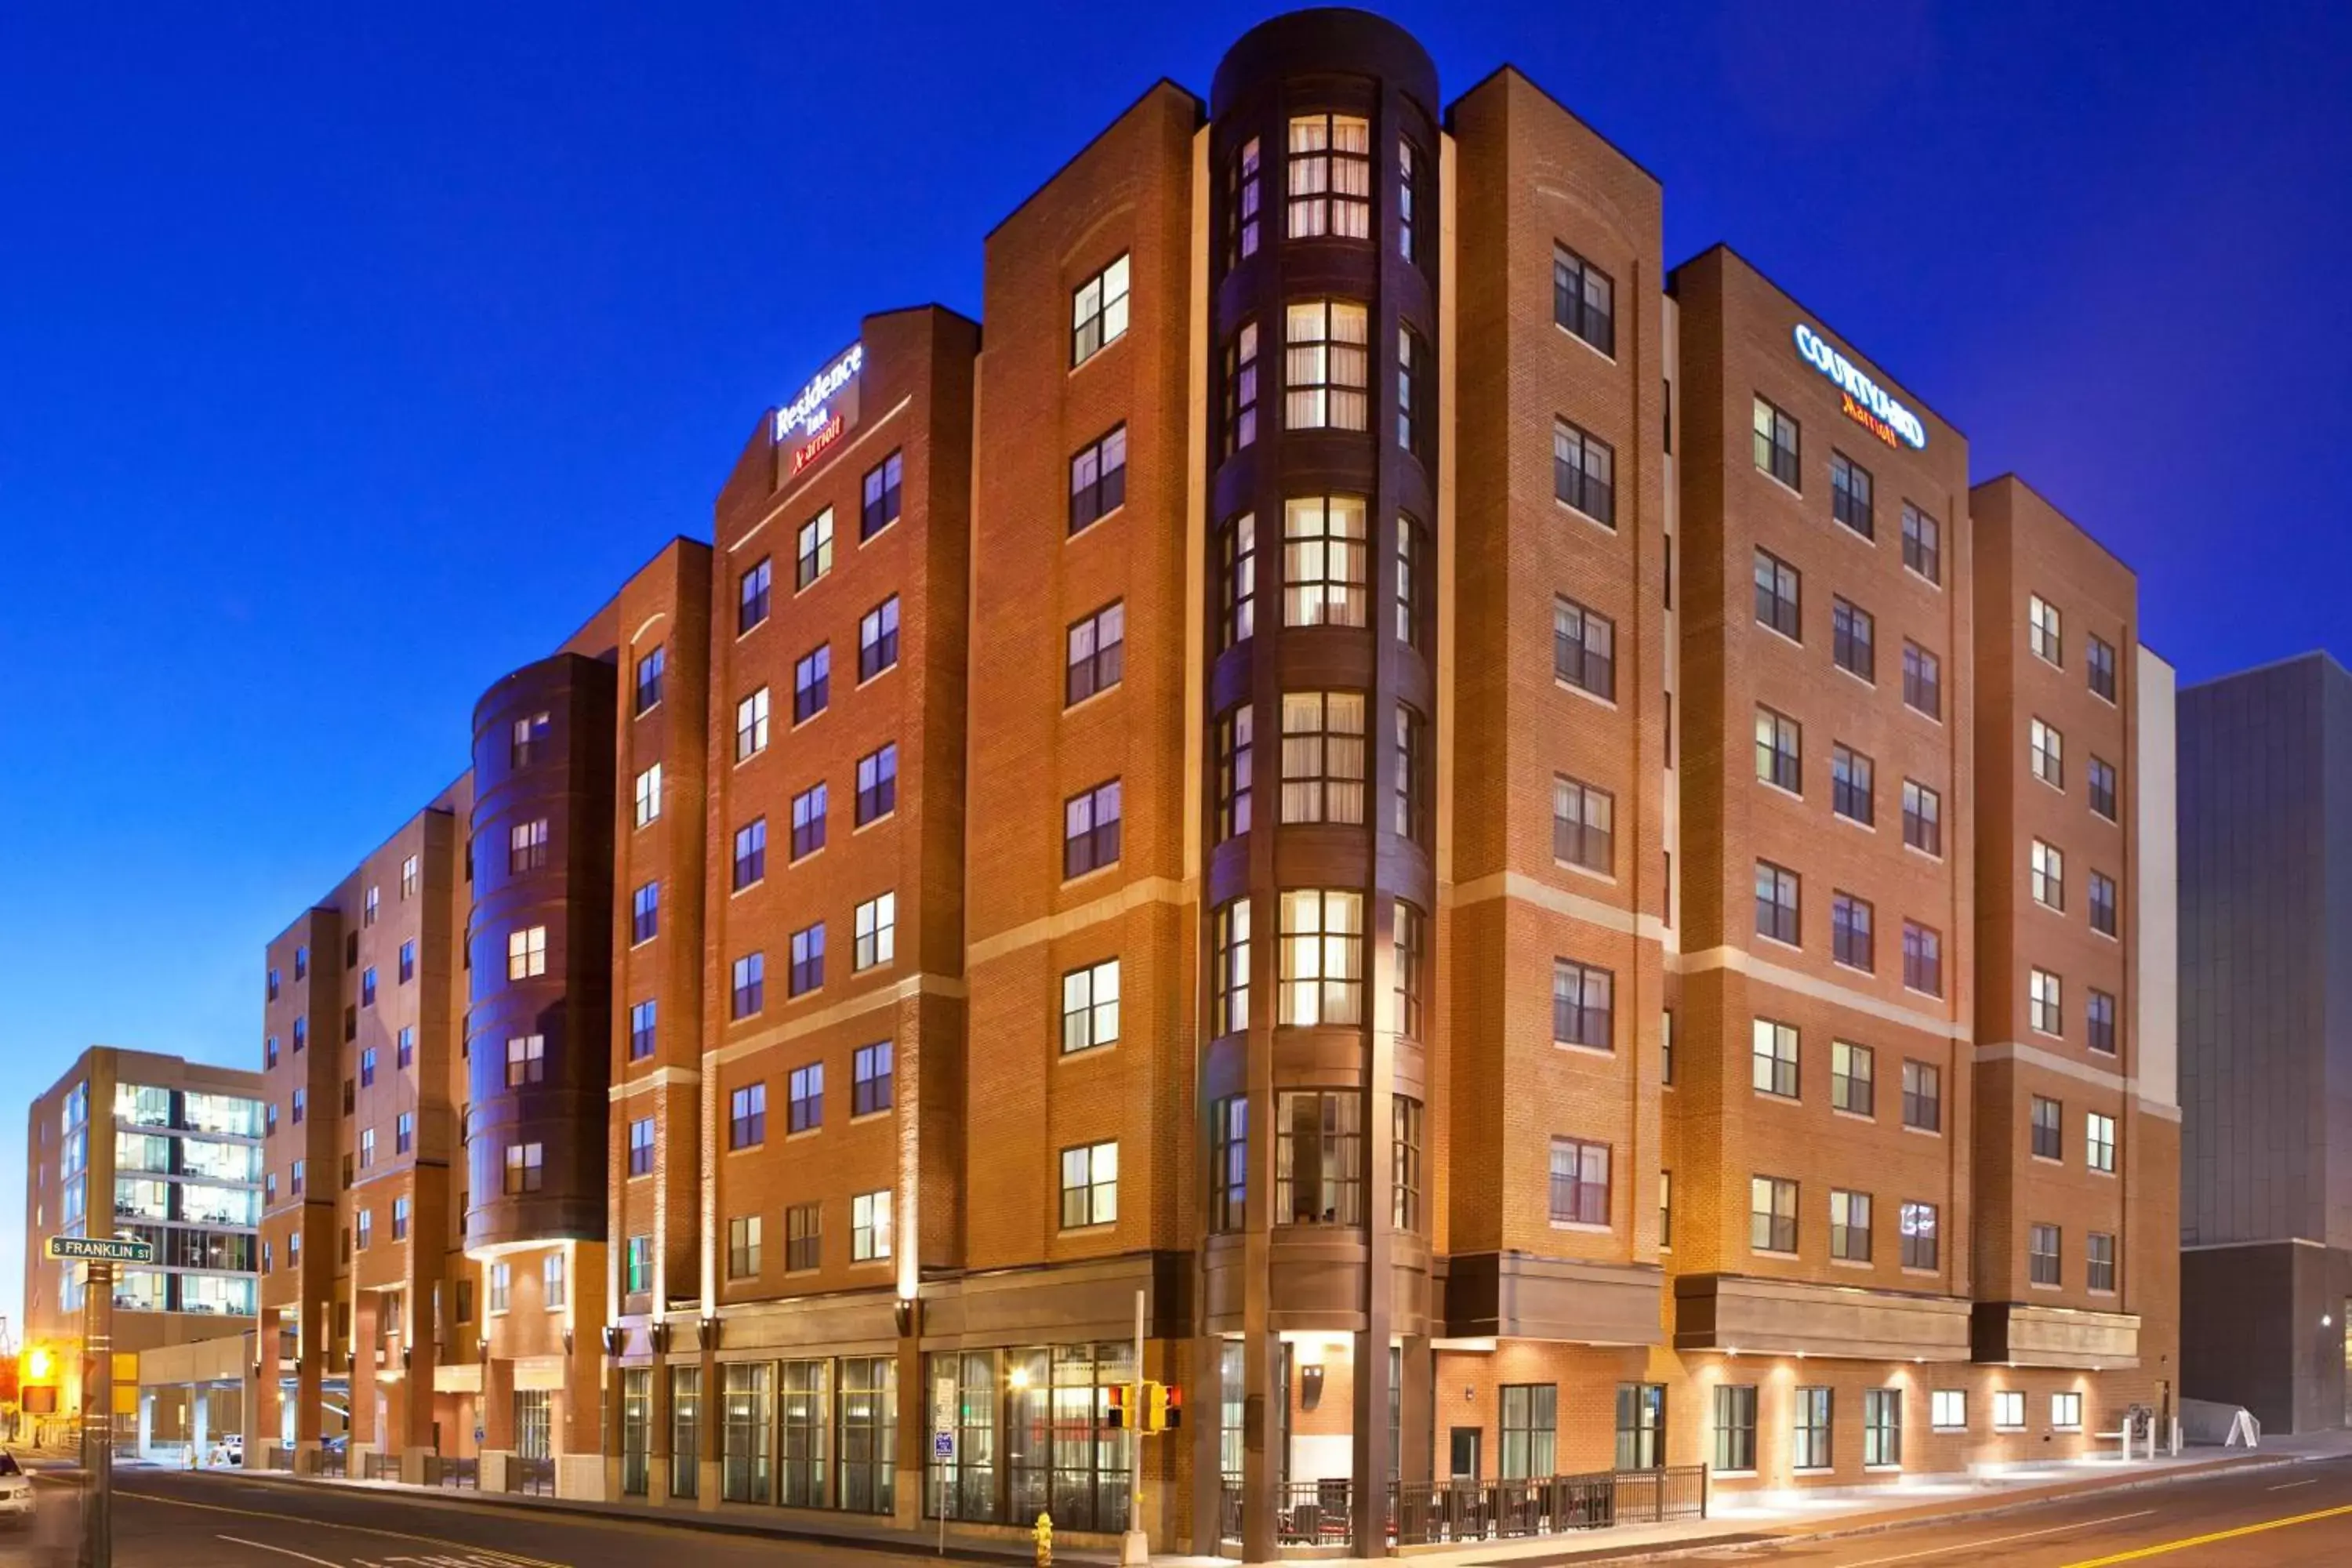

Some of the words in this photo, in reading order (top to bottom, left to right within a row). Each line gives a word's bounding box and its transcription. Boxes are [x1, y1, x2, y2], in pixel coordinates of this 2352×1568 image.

[776, 345, 862, 441] Residence
[1843, 393, 1897, 448] Marriott
[53, 1243, 61, 1253] S
[65, 1241, 132, 1258] FRANKLIN
[137, 1249, 150, 1258] ST
